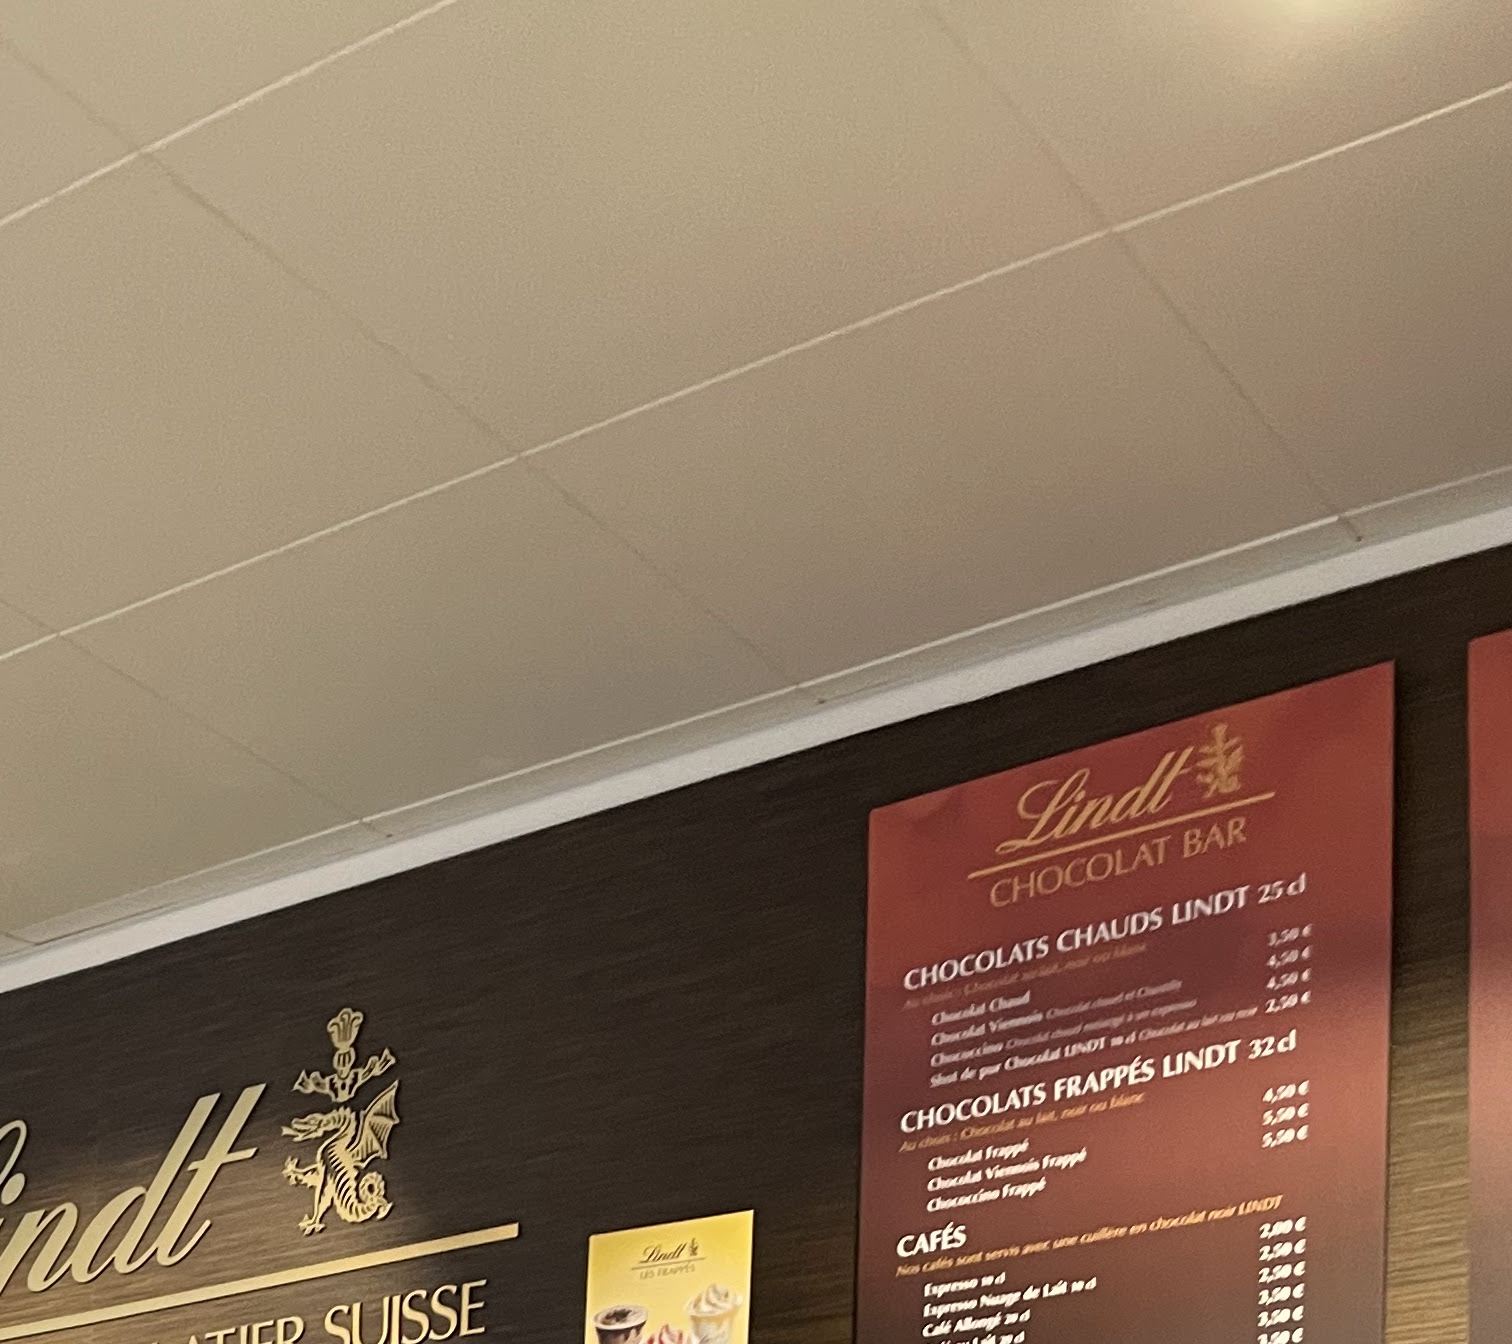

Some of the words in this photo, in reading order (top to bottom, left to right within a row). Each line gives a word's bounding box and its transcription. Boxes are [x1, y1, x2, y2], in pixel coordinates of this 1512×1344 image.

[995, 746, 1194, 854] Lindt
[990, 835, 1171, 907] CHOCOLAT
[1182, 817, 1246, 858] BAR
[904, 937, 1048, 992] CHOCOLATS
[1057, 908, 1163, 955] CHAUDS
[1172, 885, 1250, 923] LINDT
[1258, 880, 1283, 904] 25
[1287, 871, 1306, 896] cl
[900, 1083, 1046, 1133] CHOCOLATS
[1054, 1057, 1154, 1102] FRAPPÉS
[1163, 1039, 1241, 1078] LINDT
[1248, 1036, 1275, 1059] 32
[1277, 1029, 1297, 1052] cl
[927, 1170, 982, 1191] Chocolat
[985, 1158, 1040, 1180] Viennois
[1042, 1147, 1087, 1170] Frappé
[928, 1150, 983, 1171] Chocolat
[985, 1138, 1029, 1160] Frappé
[1002, 1176, 1046, 1199] Frappé
[640, 1242, 688, 1264] Lindt
[896, 1221, 967, 1257] CAFÉS
[1022, 1285, 1041, 1300] de
[1042, 1279, 1068, 1297] Lait
[921, 1319, 952, 1338] Café
[953, 1311, 1002, 1333] Allongé
